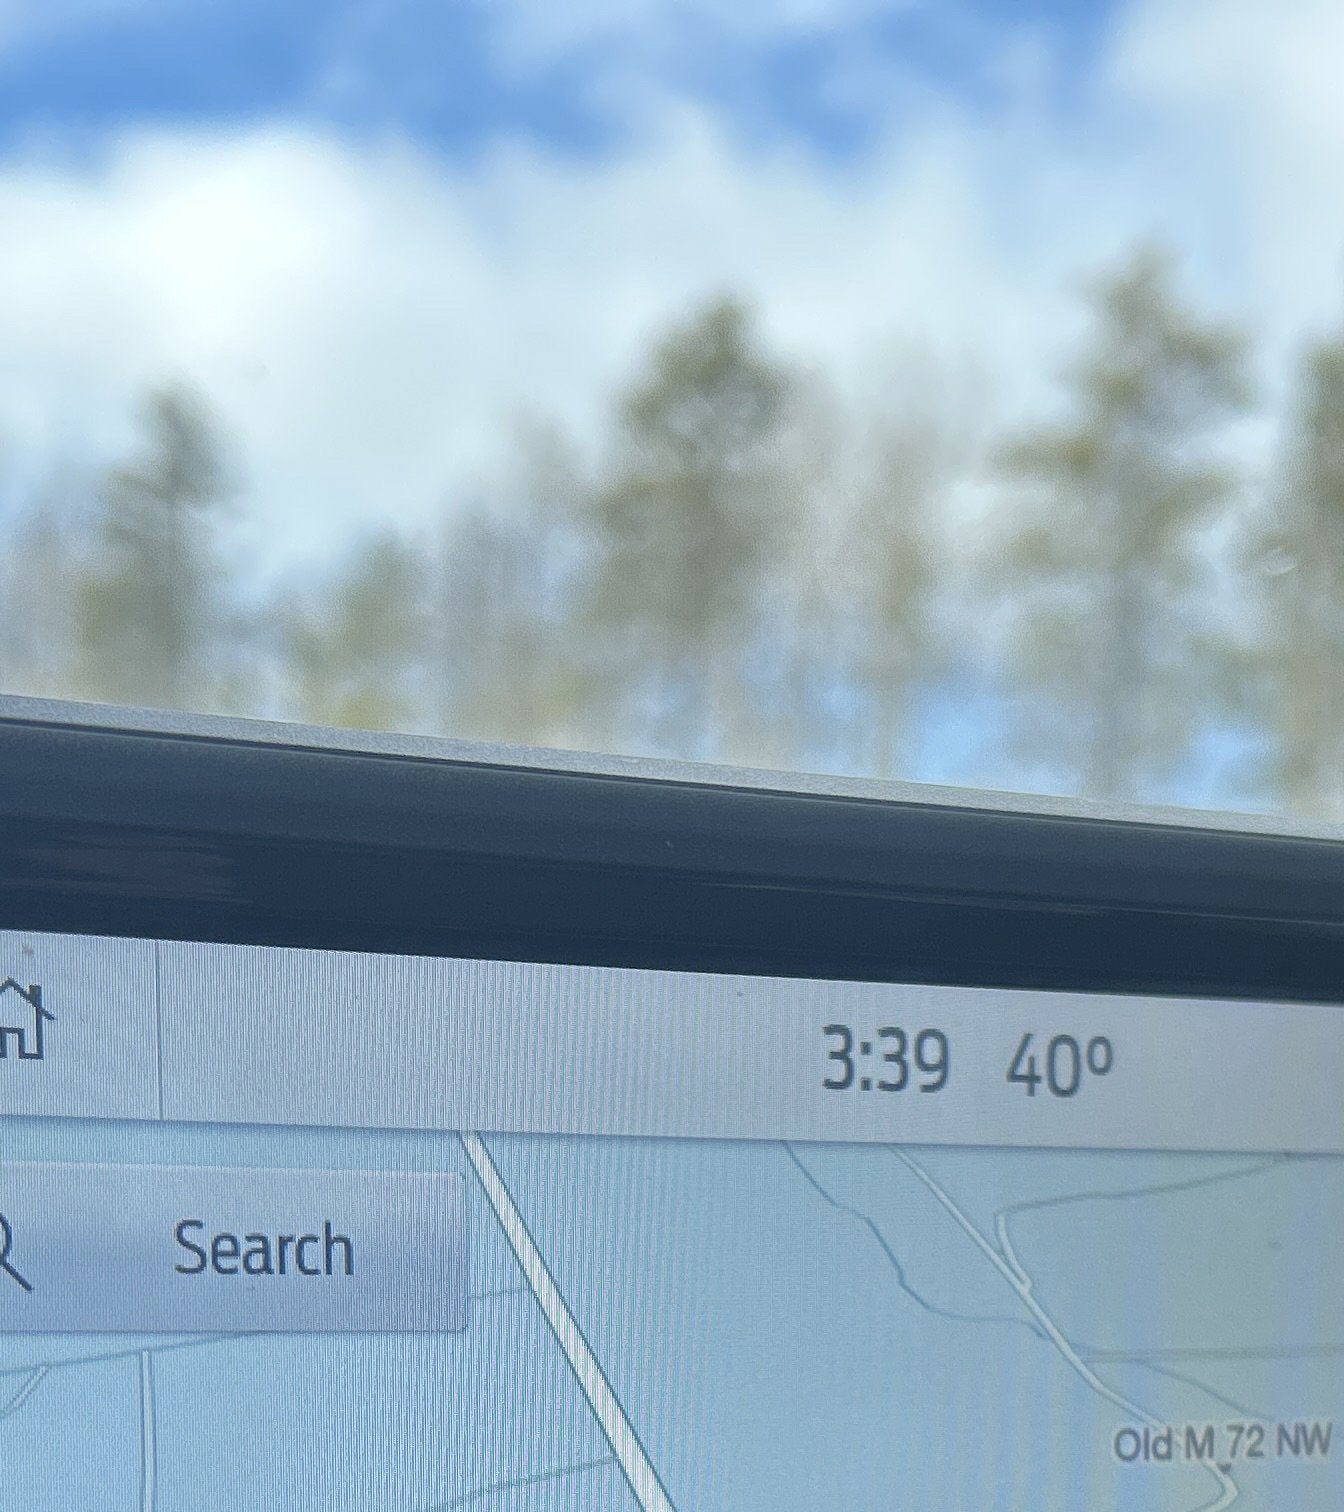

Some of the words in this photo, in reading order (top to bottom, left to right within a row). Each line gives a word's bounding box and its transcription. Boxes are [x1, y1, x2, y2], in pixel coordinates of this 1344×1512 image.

[822, 1023, 949, 1093] 3:39
[174, 1219, 355, 1276] Search
[1113, 1427, 1173, 1462] Old
[1184, 1425, 1215, 1459] M
[1226, 1424, 1265, 1458] 72
[1276, 1422, 1334, 1456] NW
